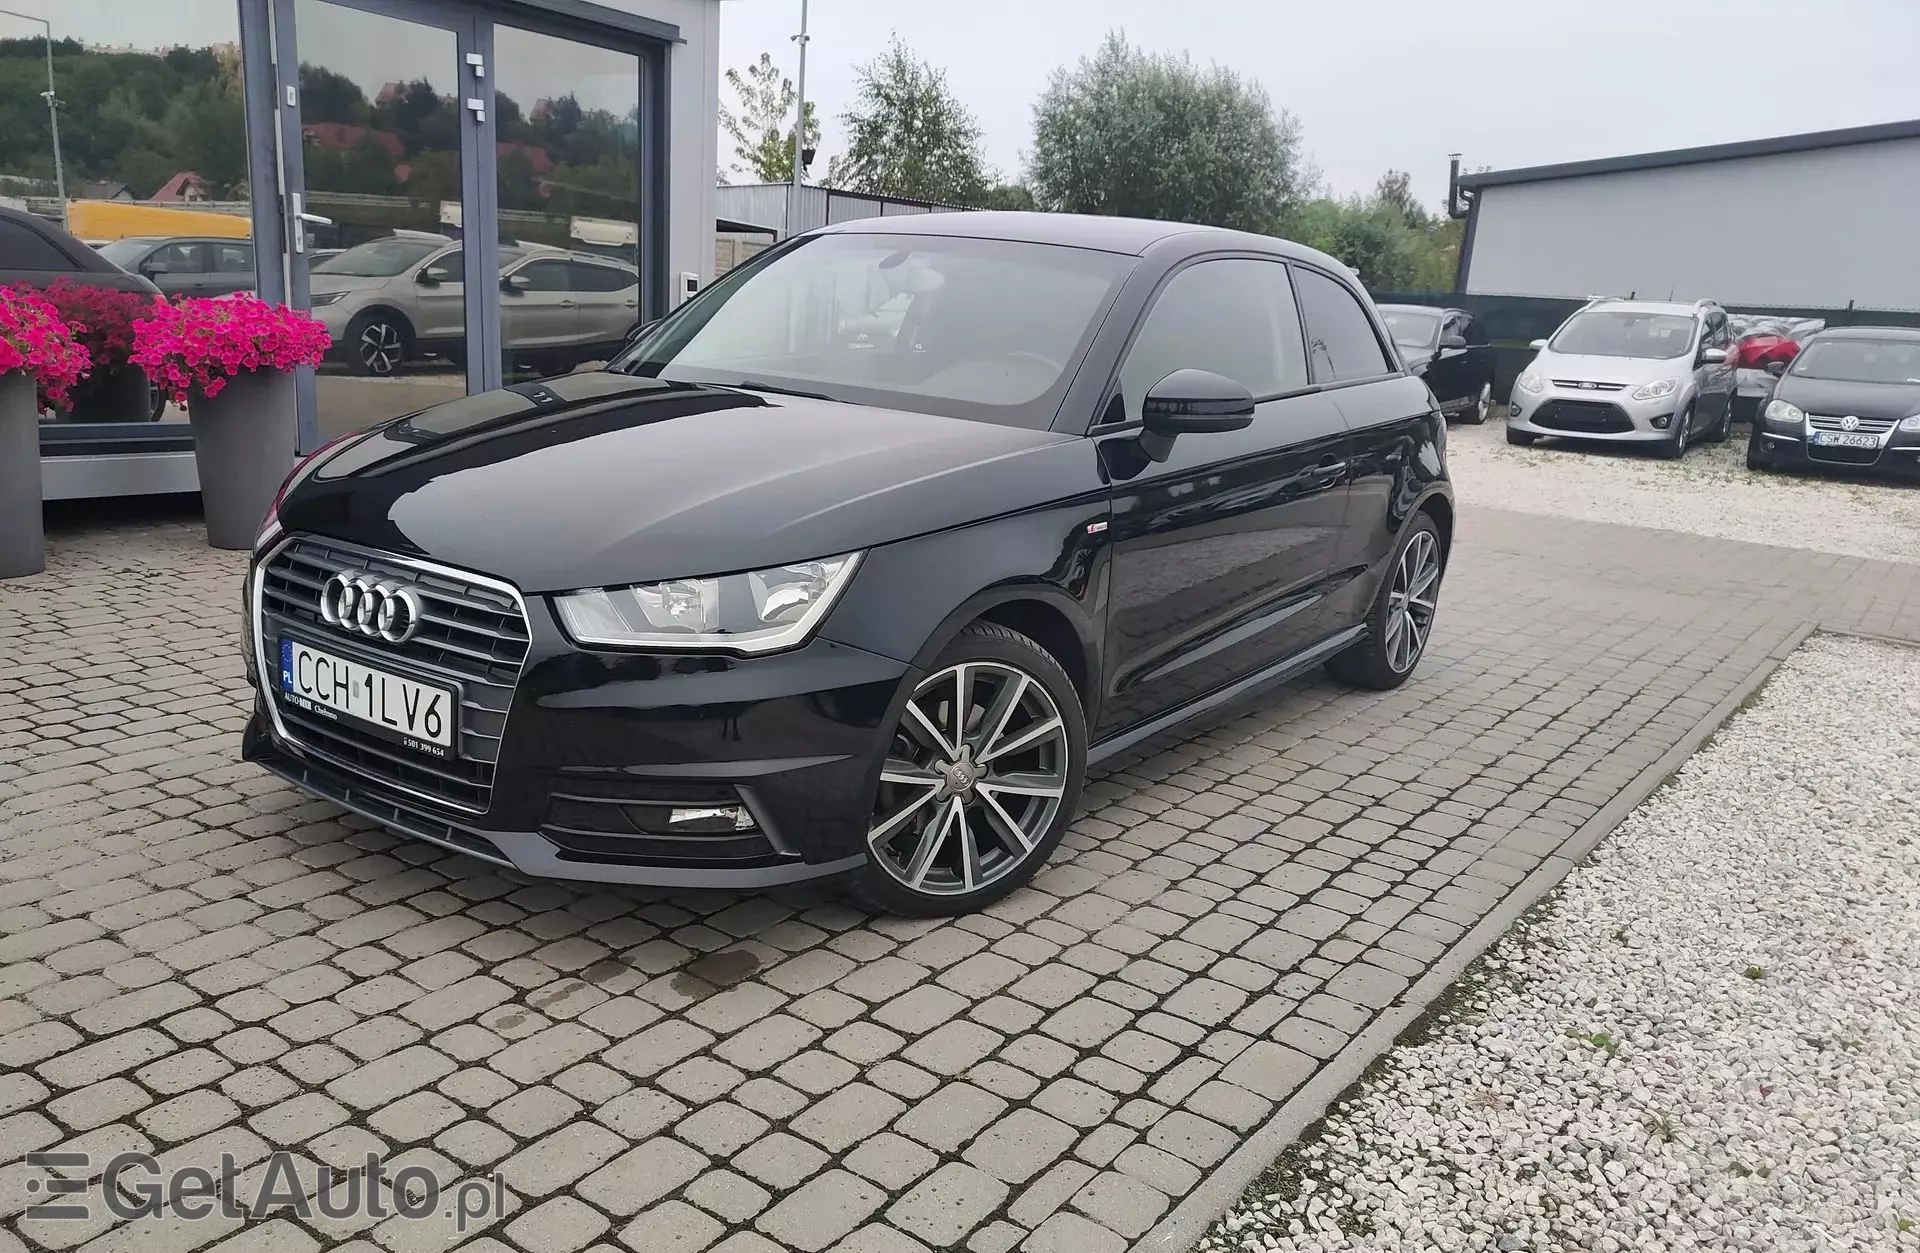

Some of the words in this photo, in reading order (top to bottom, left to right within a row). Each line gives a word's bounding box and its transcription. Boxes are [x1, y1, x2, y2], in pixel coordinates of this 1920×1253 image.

[1820, 433, 1840, 444] CSW
[1843, 436, 1876, 446] 26623
[283, 670, 293, 684] PL
[298, 650, 350, 709] CCH
[364, 673, 442, 738] 1LV6
[408, 739, 418, 749] 501
[420, 743, 431, 753] 399
[432, 747, 444, 757] 654
